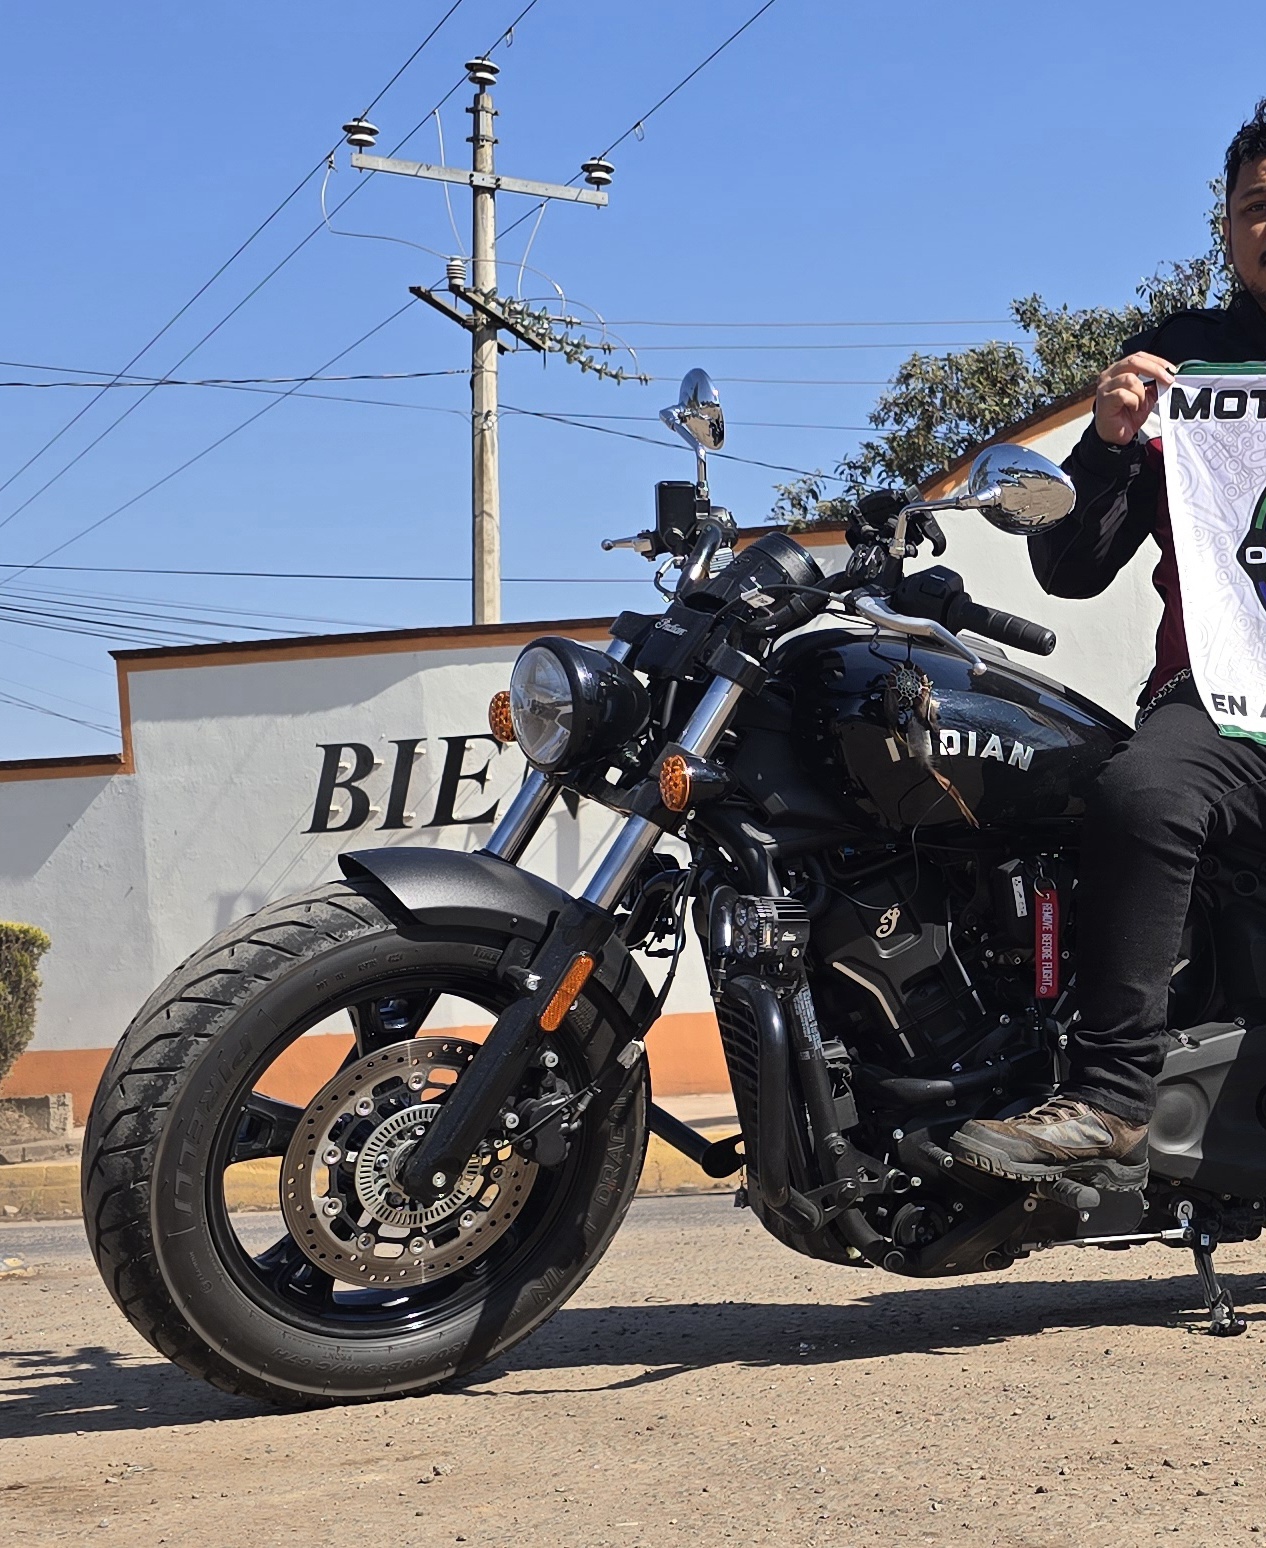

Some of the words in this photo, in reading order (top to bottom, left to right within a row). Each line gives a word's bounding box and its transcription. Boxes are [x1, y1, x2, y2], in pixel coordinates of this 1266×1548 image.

[1211, 693, 1247, 716] EN
[1041, 902, 1053, 931] REMOVE
[1041, 933, 1053, 960] BEFORE
[1041, 962, 1053, 987] FLIGHT
